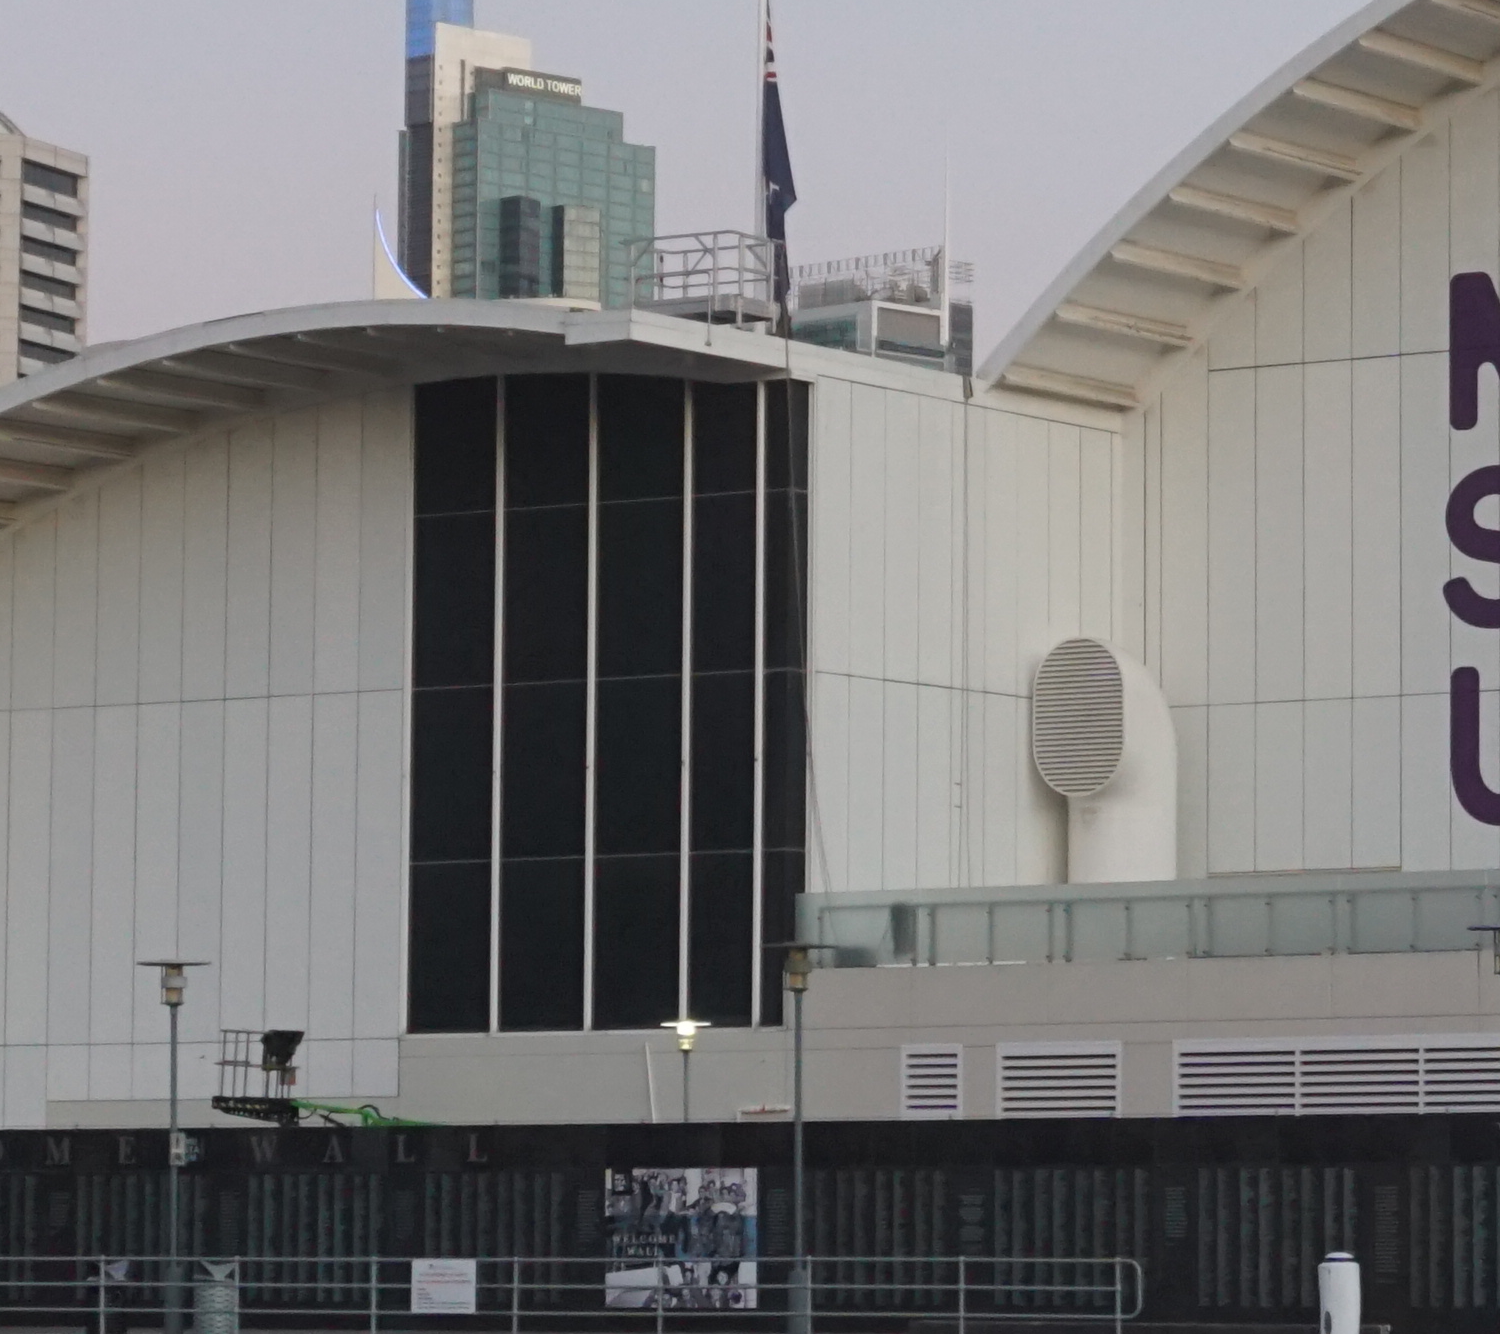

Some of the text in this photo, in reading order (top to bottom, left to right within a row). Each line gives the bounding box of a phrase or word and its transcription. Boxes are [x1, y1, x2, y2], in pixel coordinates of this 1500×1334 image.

[507, 72, 582, 97] WORLD TOWER
[250, 1133, 488, 1164] WALL
[612, 1233, 676, 1244] WELCOME
[626, 1246, 659, 1256] WALL
